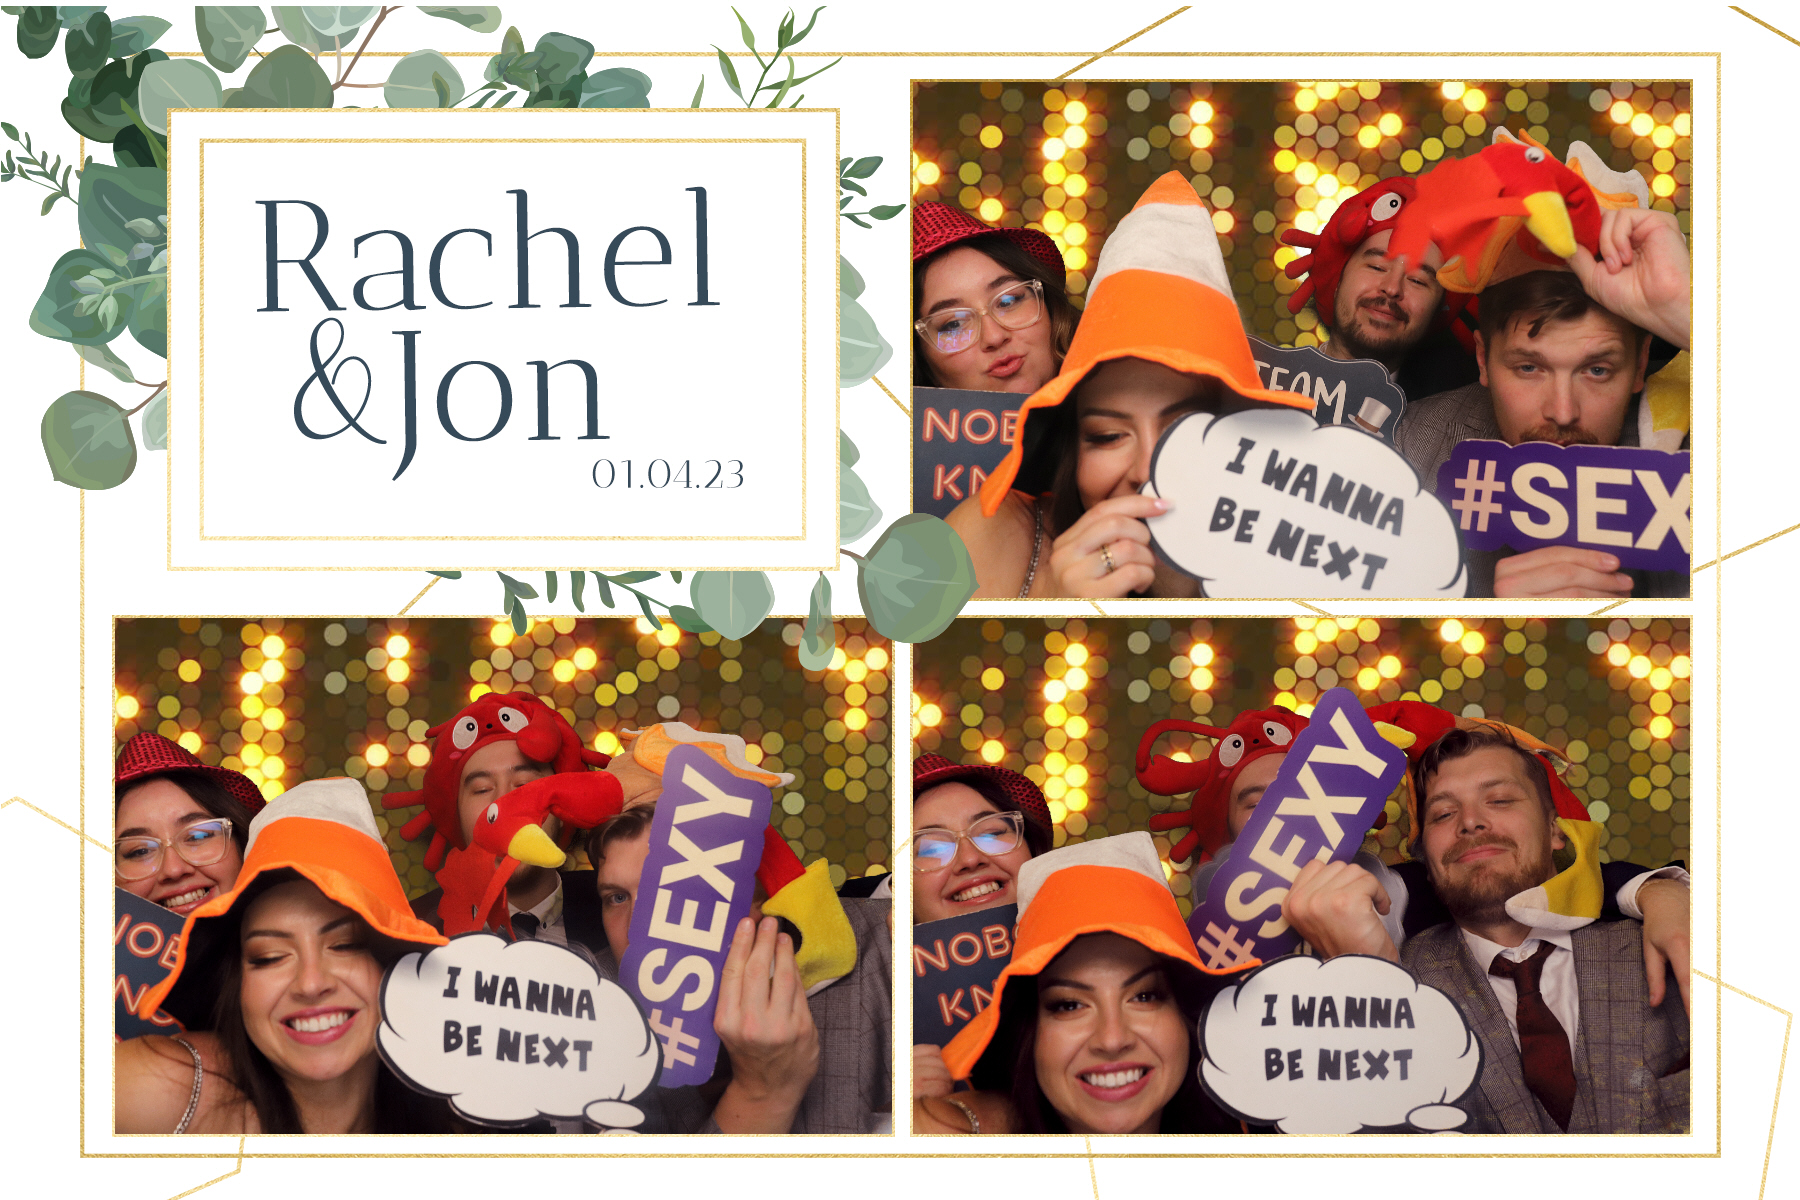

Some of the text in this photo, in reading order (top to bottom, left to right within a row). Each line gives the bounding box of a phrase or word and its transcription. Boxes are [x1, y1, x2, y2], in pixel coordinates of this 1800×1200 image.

[1225, 437, 1404, 537] I WANNA
[1209, 496, 1388, 591] BE NEXT
[638, 763, 753, 1069] #SEXY
[442, 966, 596, 1021] I WANNA
[1261, 993, 1416, 1029] I WANNA
[443, 1020, 593, 1072] BE NEXT
[1264, 1047, 1413, 1082] BE NEXT
